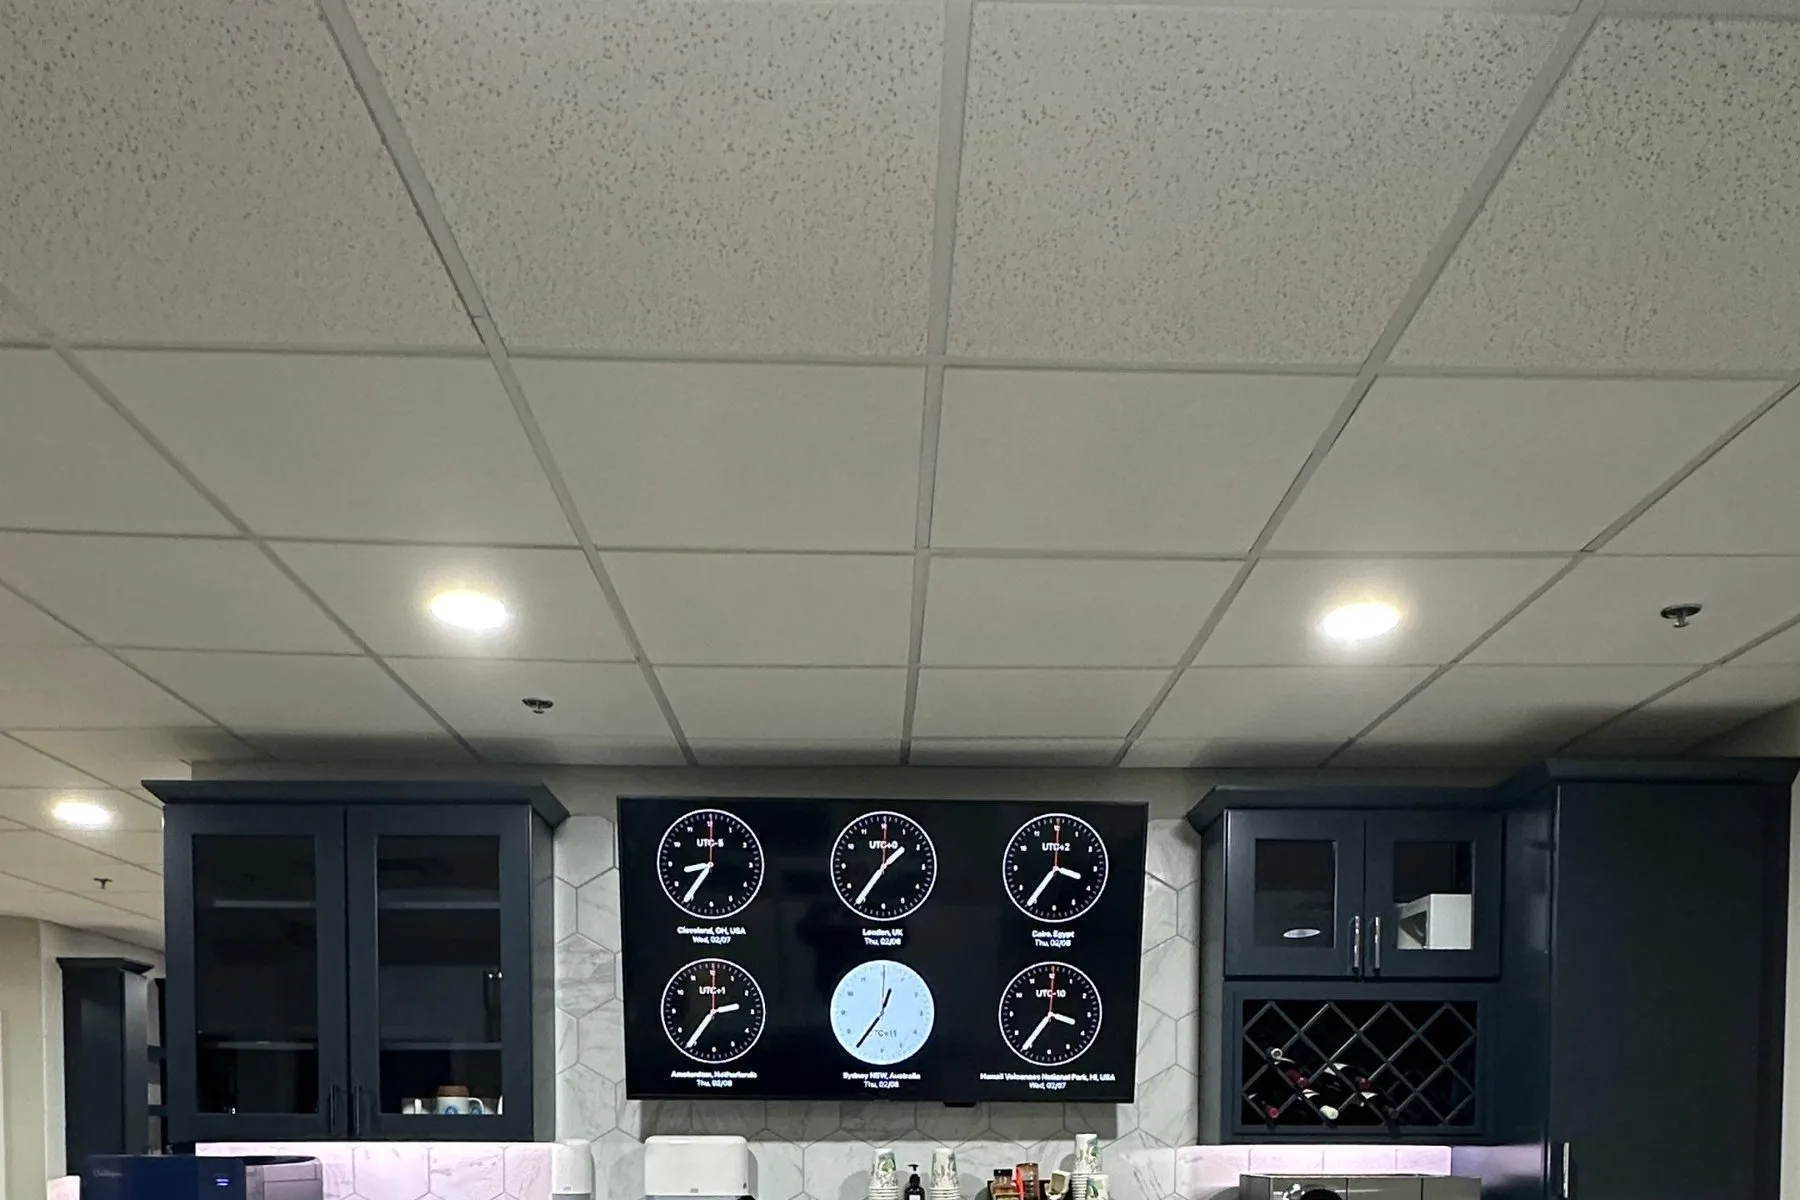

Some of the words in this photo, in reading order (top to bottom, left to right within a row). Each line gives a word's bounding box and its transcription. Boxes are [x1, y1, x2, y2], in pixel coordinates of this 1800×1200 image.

[696, 838, 724, 848] UTC-5
[869, 841, 898, 849] UTC+0
[1042, 842, 1070, 851] UTC+2
[730, 927, 746, 935] USA
[862, 929, 891, 937] London,
[1053, 930, 1075, 939] Egypt
[711, 936, 731, 944] 02/07
[699, 986, 726, 995] UTC+1
[1035, 989, 1067, 998] UTC-10
[842, 1072, 869, 1080] Sydney
[889, 1072, 921, 1080] Australia
